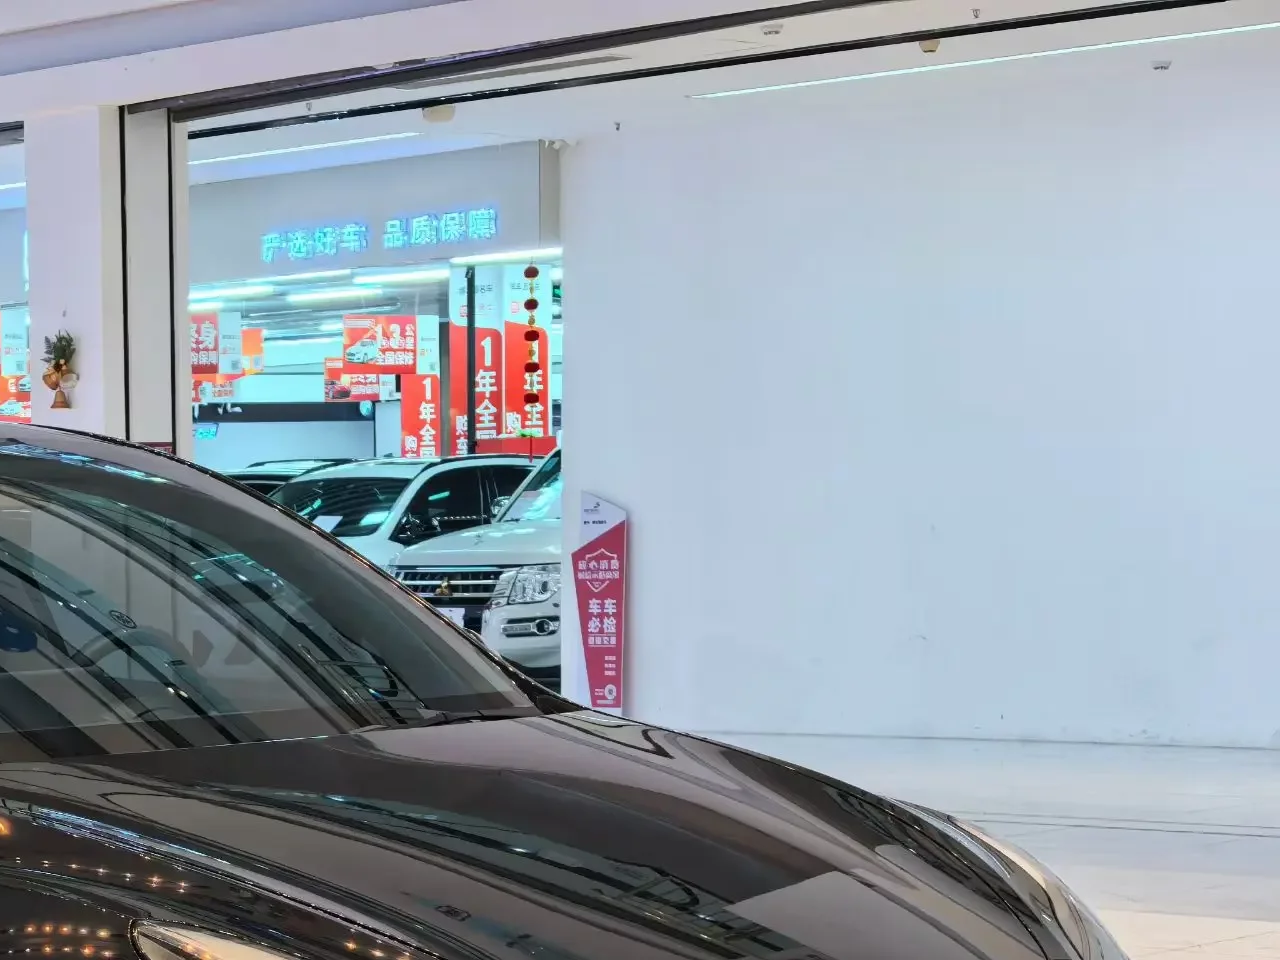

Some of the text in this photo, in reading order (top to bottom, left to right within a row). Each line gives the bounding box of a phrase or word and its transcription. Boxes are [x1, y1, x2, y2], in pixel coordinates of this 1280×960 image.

[382, 208, 497, 249] 品质保障
[588, 598, 617, 616] 车车
